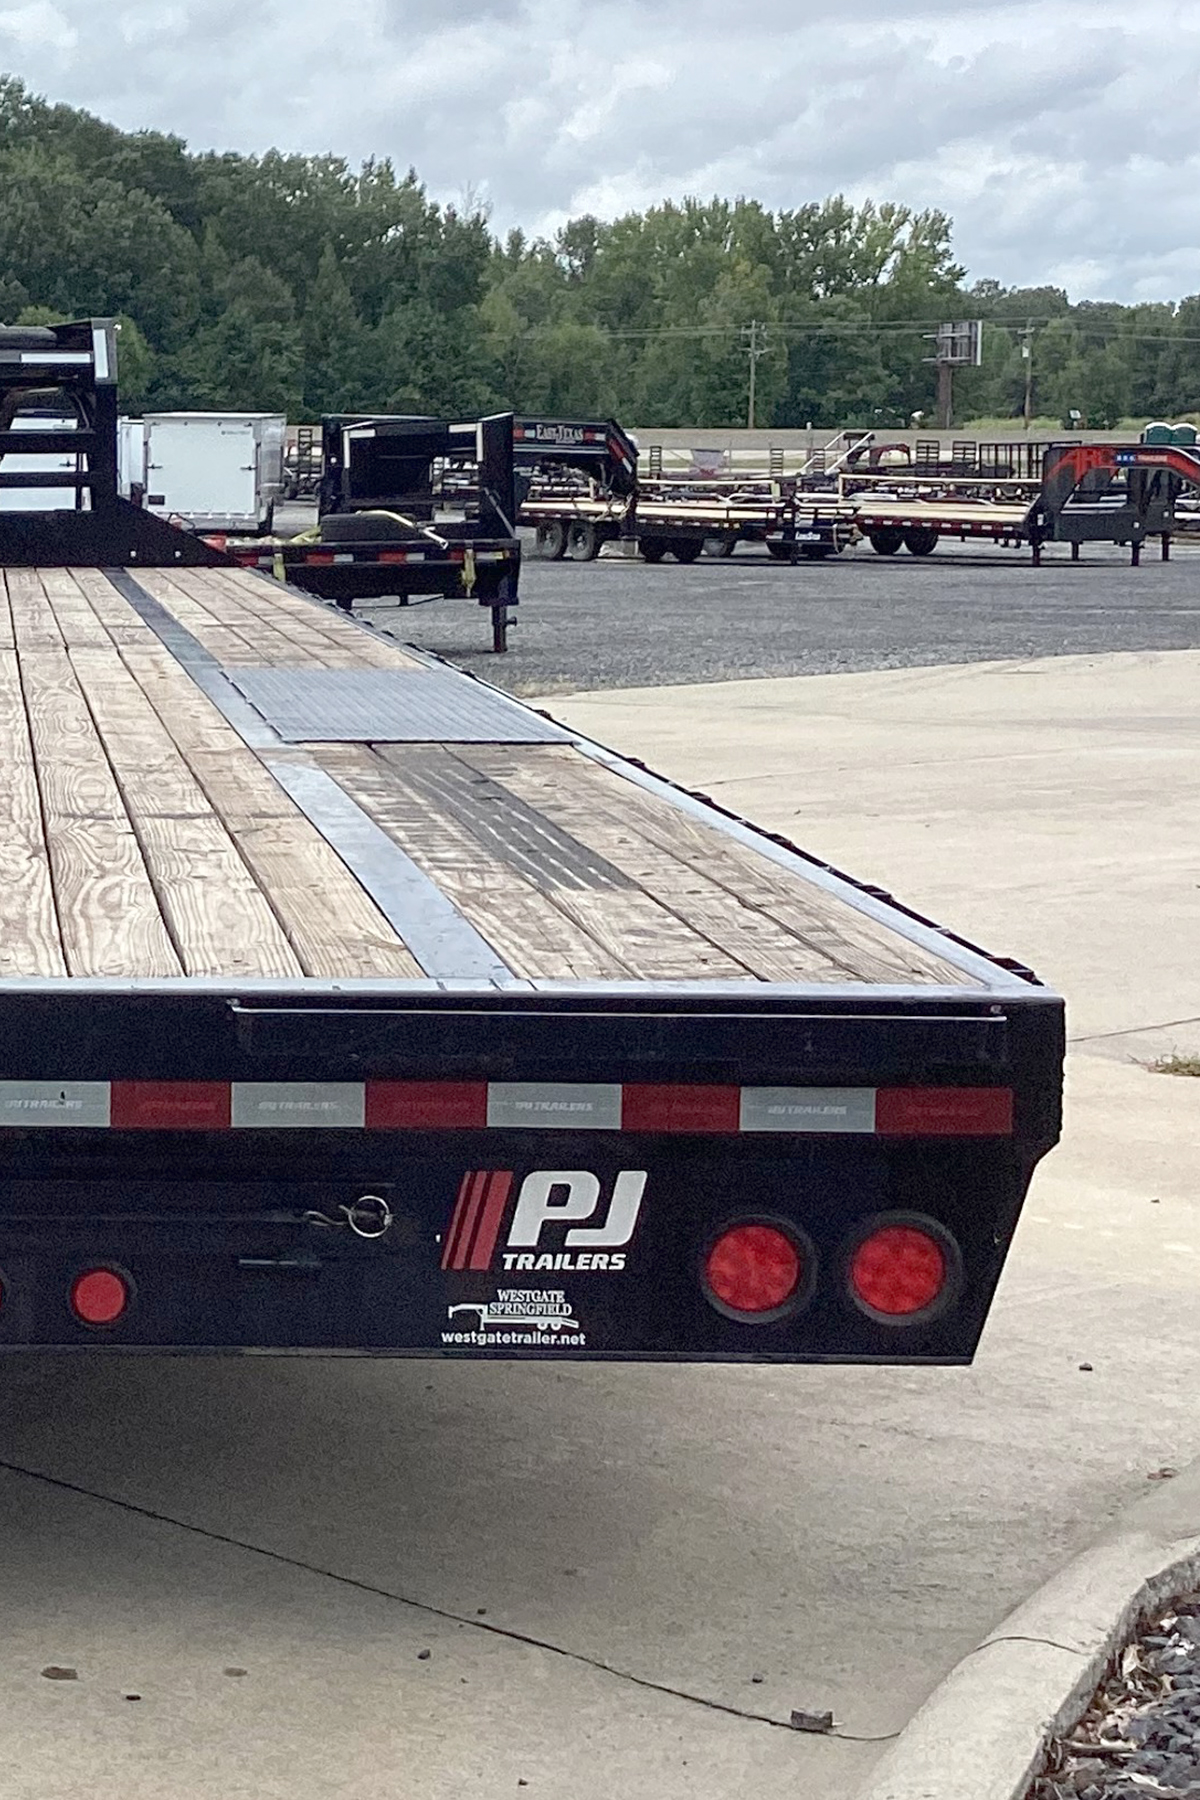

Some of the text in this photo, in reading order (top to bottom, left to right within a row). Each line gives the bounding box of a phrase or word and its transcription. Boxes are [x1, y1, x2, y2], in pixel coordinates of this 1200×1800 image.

[506, 1170, 648, 1247] PJ
[502, 1253, 627, 1271] TRAILERS
[497, 1289, 565, 1303] WESTGATE
[489, 1302, 572, 1316] SPRINGFIELD
[441, 1331, 586, 1346] westgatetrailer.net
